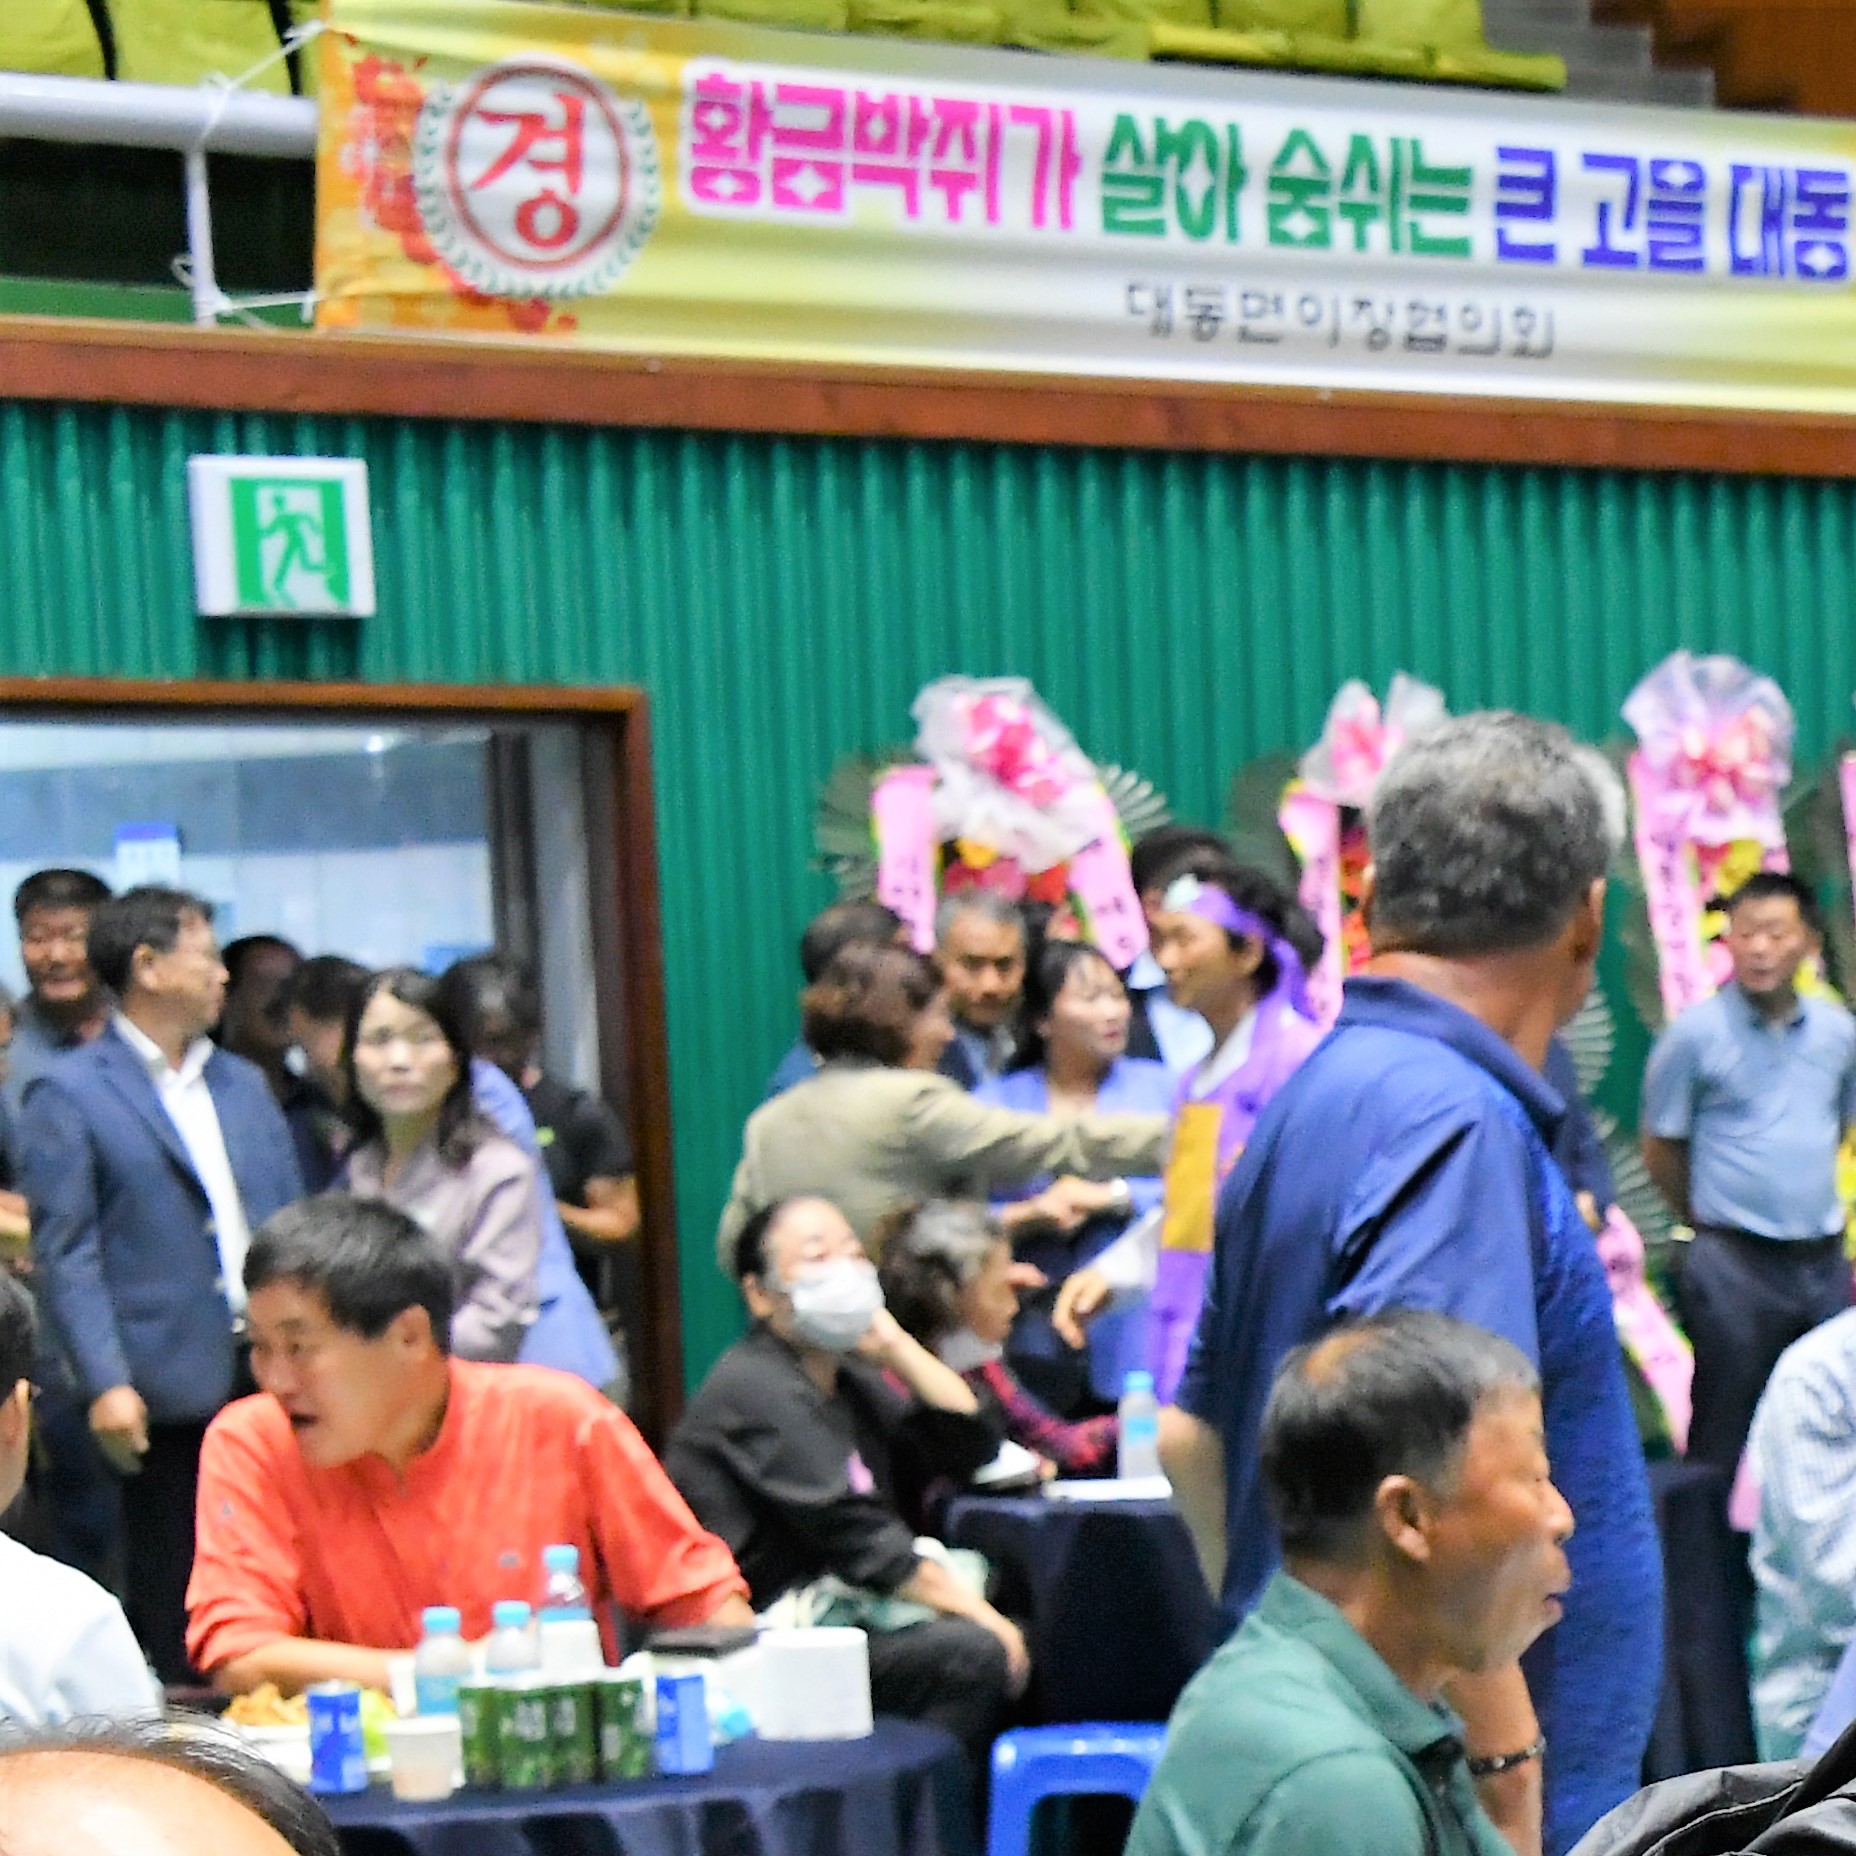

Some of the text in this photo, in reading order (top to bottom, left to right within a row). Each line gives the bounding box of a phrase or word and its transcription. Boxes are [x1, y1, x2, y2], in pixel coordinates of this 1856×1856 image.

[472, 92, 586, 251] 경
[689, 72, 1852, 281] 황금박쥐가 살아 숨쉬는 큰 고을 대동
[1122, 279, 1557, 362] 대동면이장협의회
